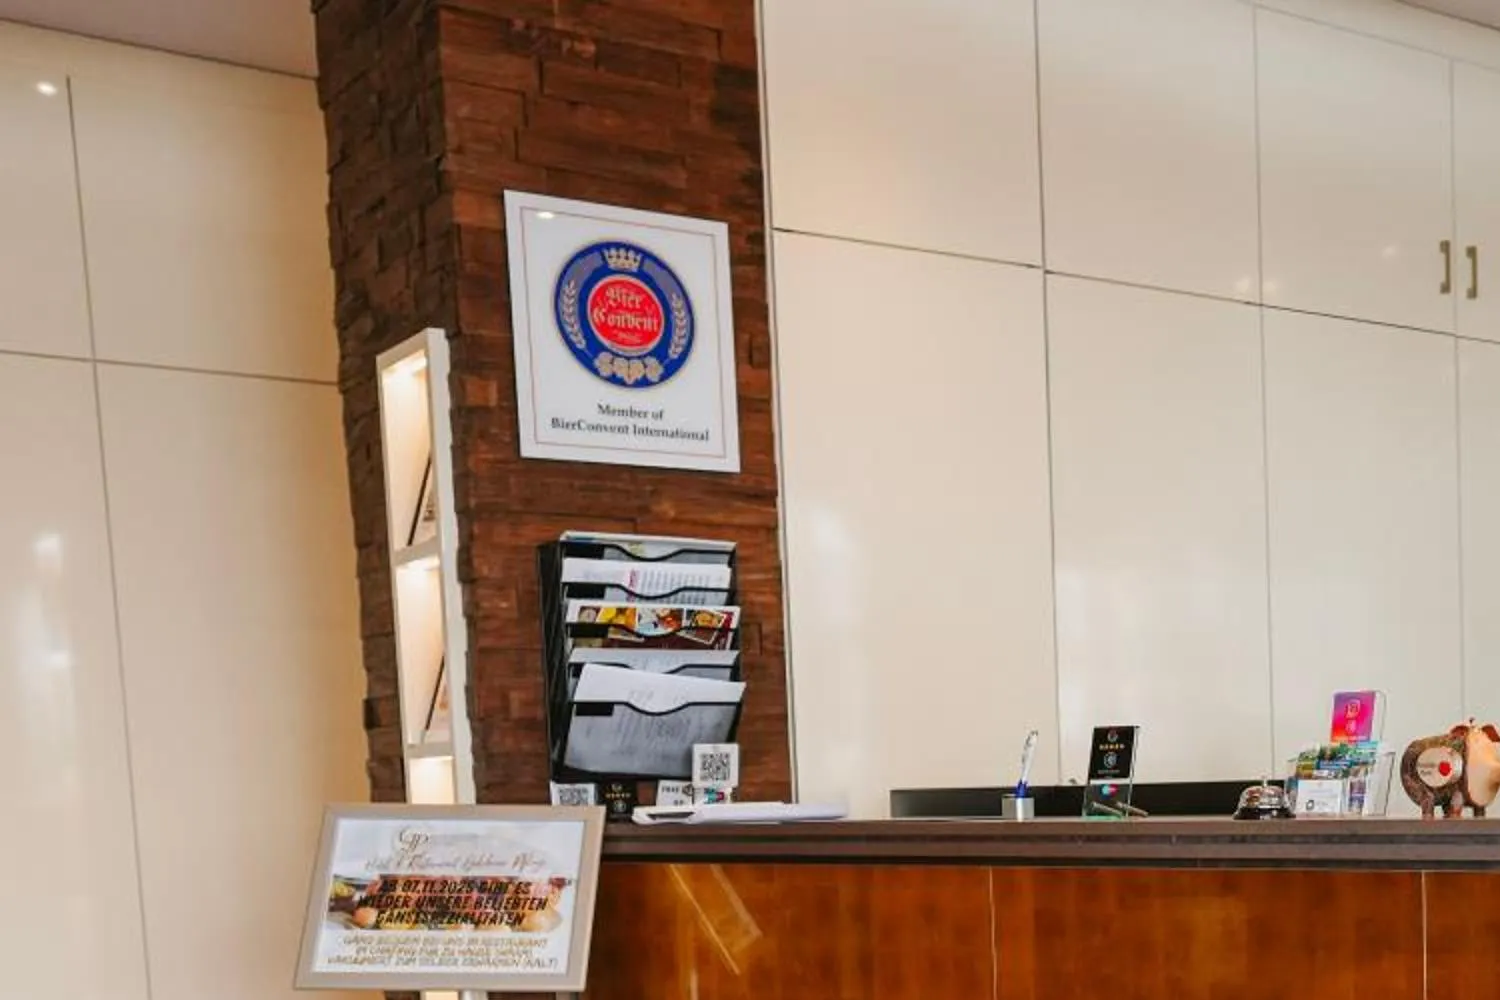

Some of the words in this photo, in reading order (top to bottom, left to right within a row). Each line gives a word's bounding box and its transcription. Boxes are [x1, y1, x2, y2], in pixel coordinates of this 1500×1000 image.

[597, 402, 648, 419] Member
[650, 408, 665, 421] of
[551, 416, 629, 435] BierConvent
[633, 423, 711, 442] International
[358, 895, 410, 909] WIEDER
